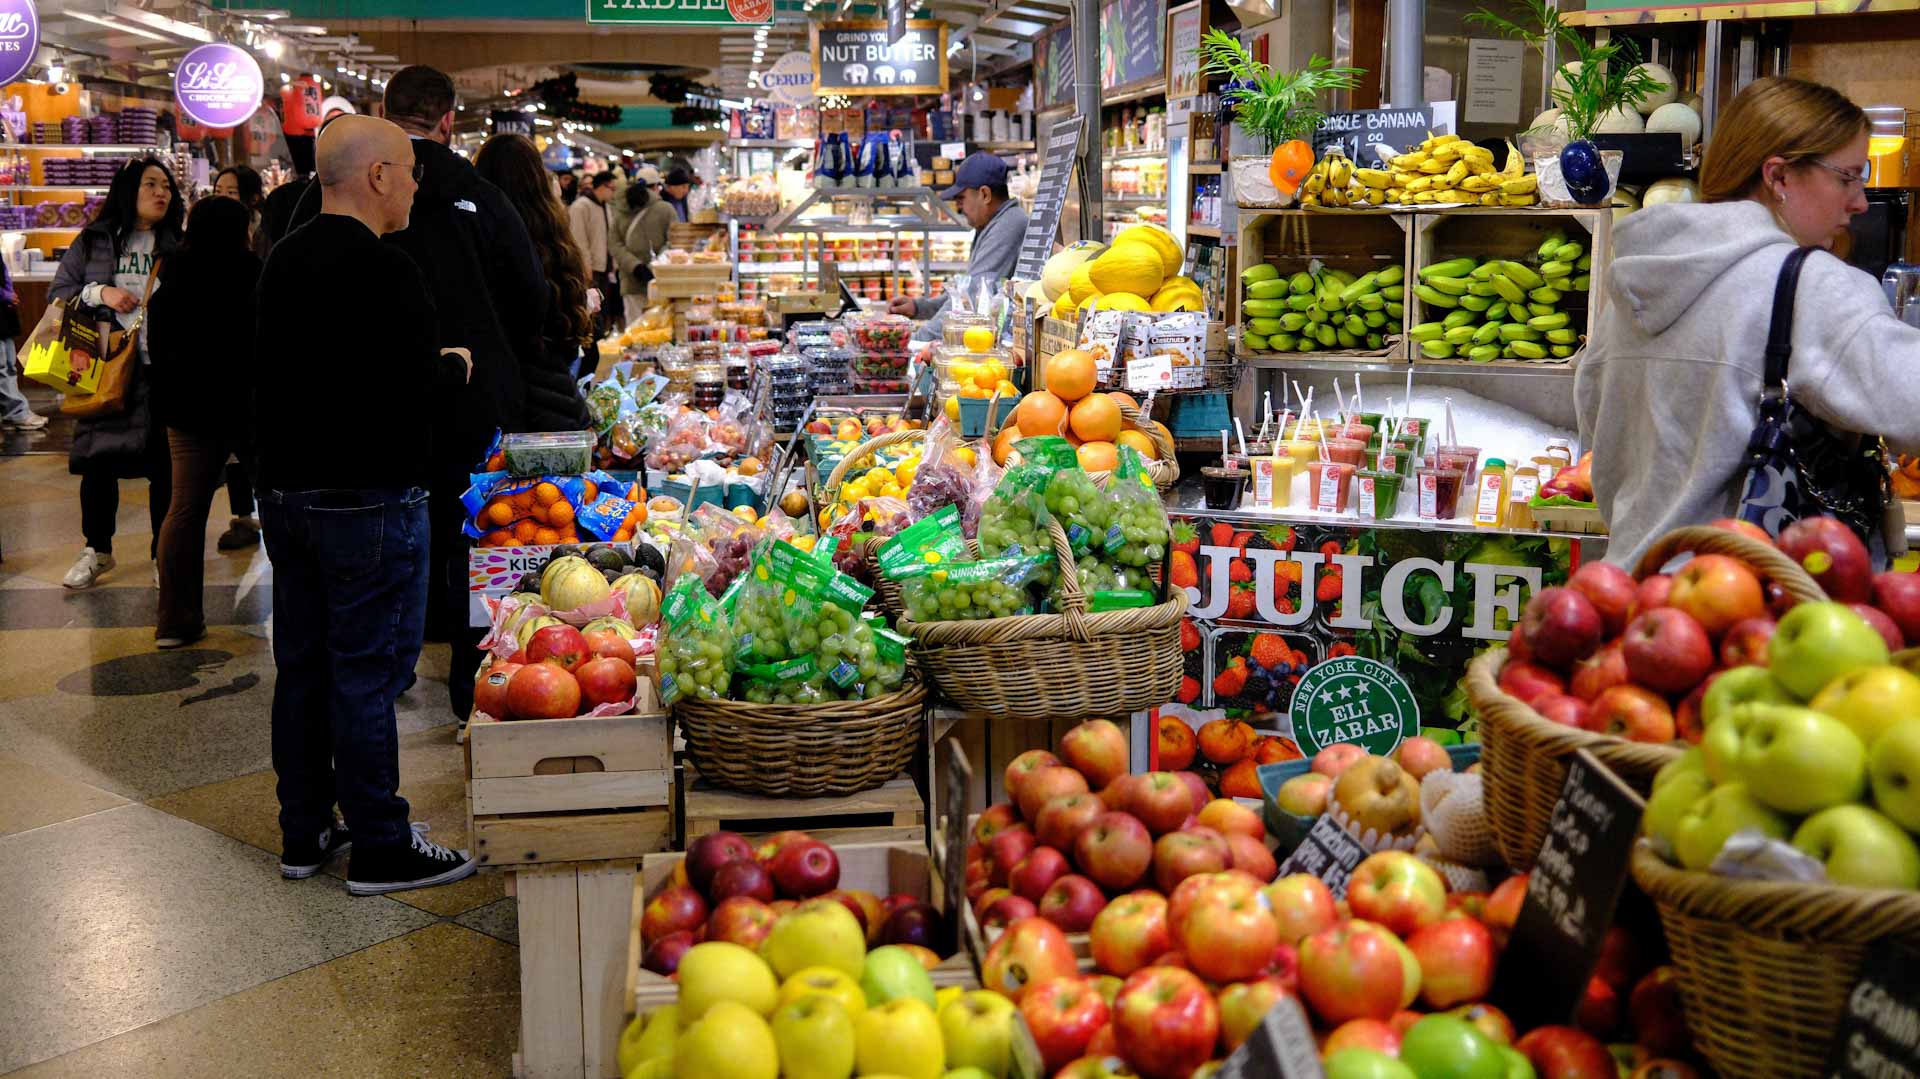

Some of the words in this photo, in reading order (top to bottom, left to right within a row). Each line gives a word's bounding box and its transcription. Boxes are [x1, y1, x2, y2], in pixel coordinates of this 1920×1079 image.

[836, 32, 867, 42] GRIND
[869, 32, 888, 42] YOU
[822, 45, 860, 62] NUT
[865, 44, 936, 62] BUTTER
[1315, 113, 1361, 131] SINGLE
[1366, 111, 1427, 130] BANANA
[1185, 545, 1543, 641] JUICE
[1295, 679, 1316, 712] NEW
[1315, 661, 1357, 680] YORK
[1363, 663, 1399, 689] CITY
[1329, 699, 1372, 723] ELI
[1317, 713, 1399, 747] ZABAR
